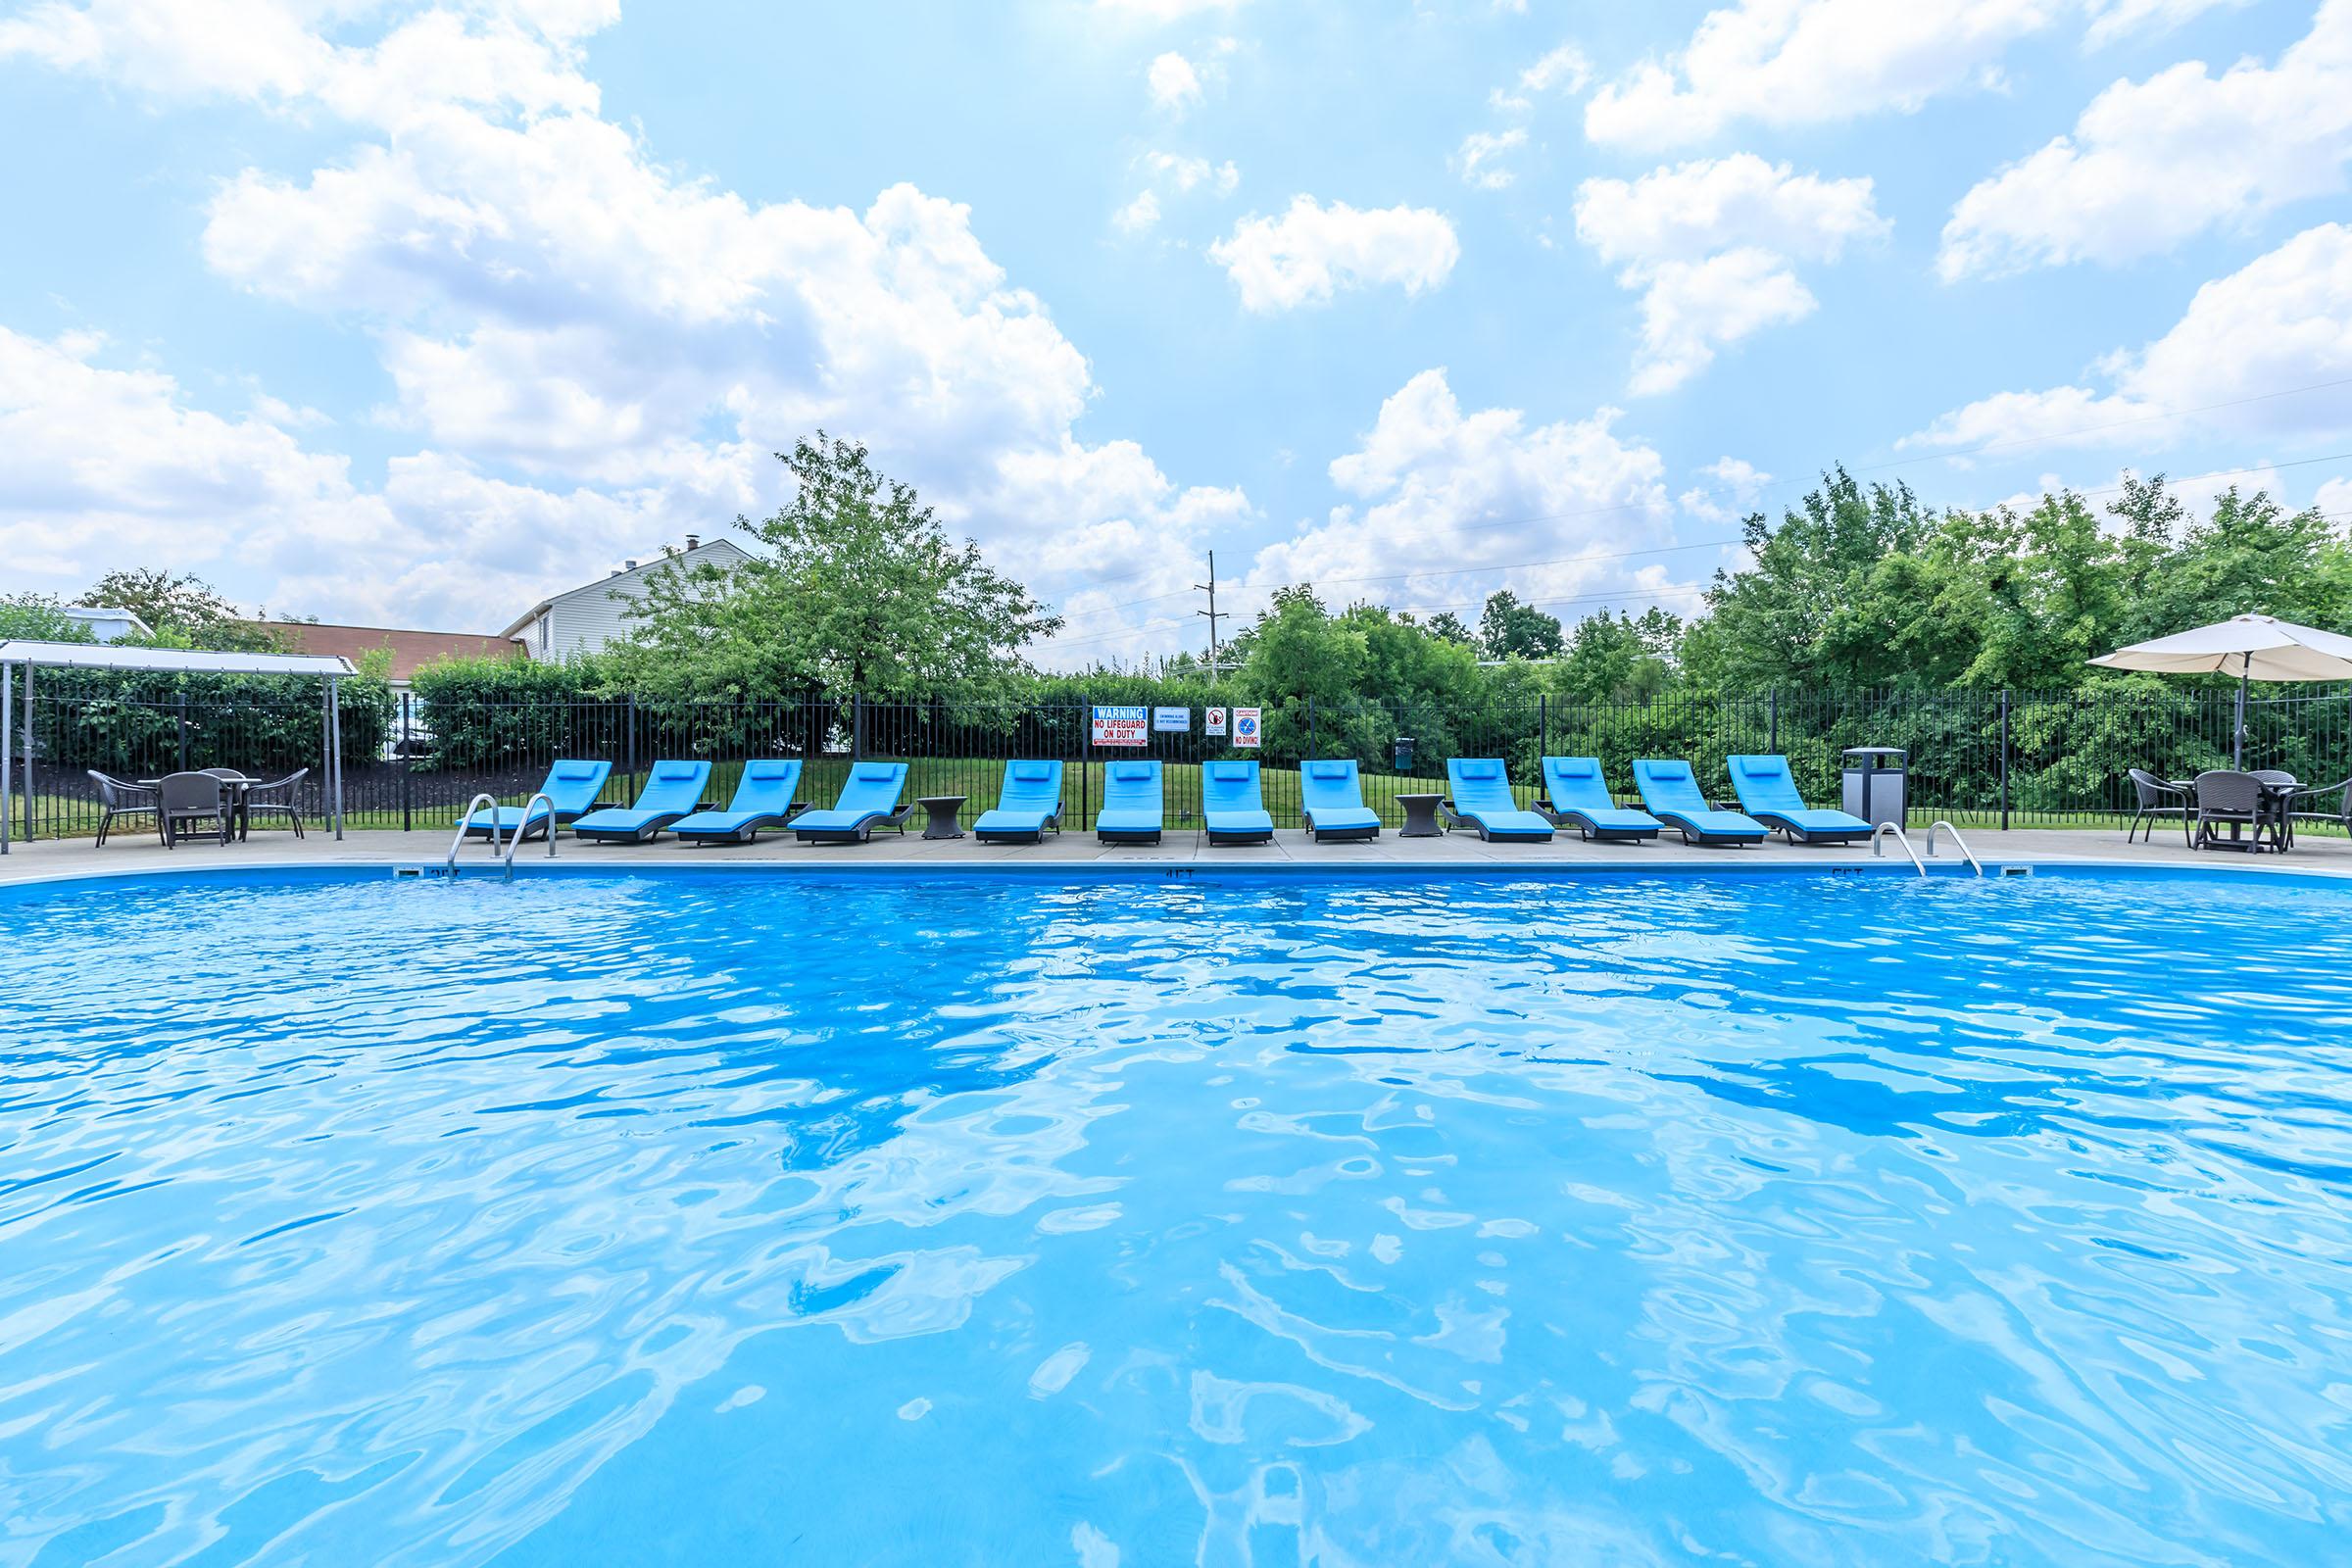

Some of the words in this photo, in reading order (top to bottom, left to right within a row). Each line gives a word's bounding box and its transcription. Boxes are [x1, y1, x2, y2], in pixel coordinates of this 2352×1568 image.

[1098, 708, 1143, 719] WARNING
[1107, 720, 1146, 729] LIFEGUARD
[1103, 729, 1114, 738] ON
[1116, 729, 1136, 738] DUTY
